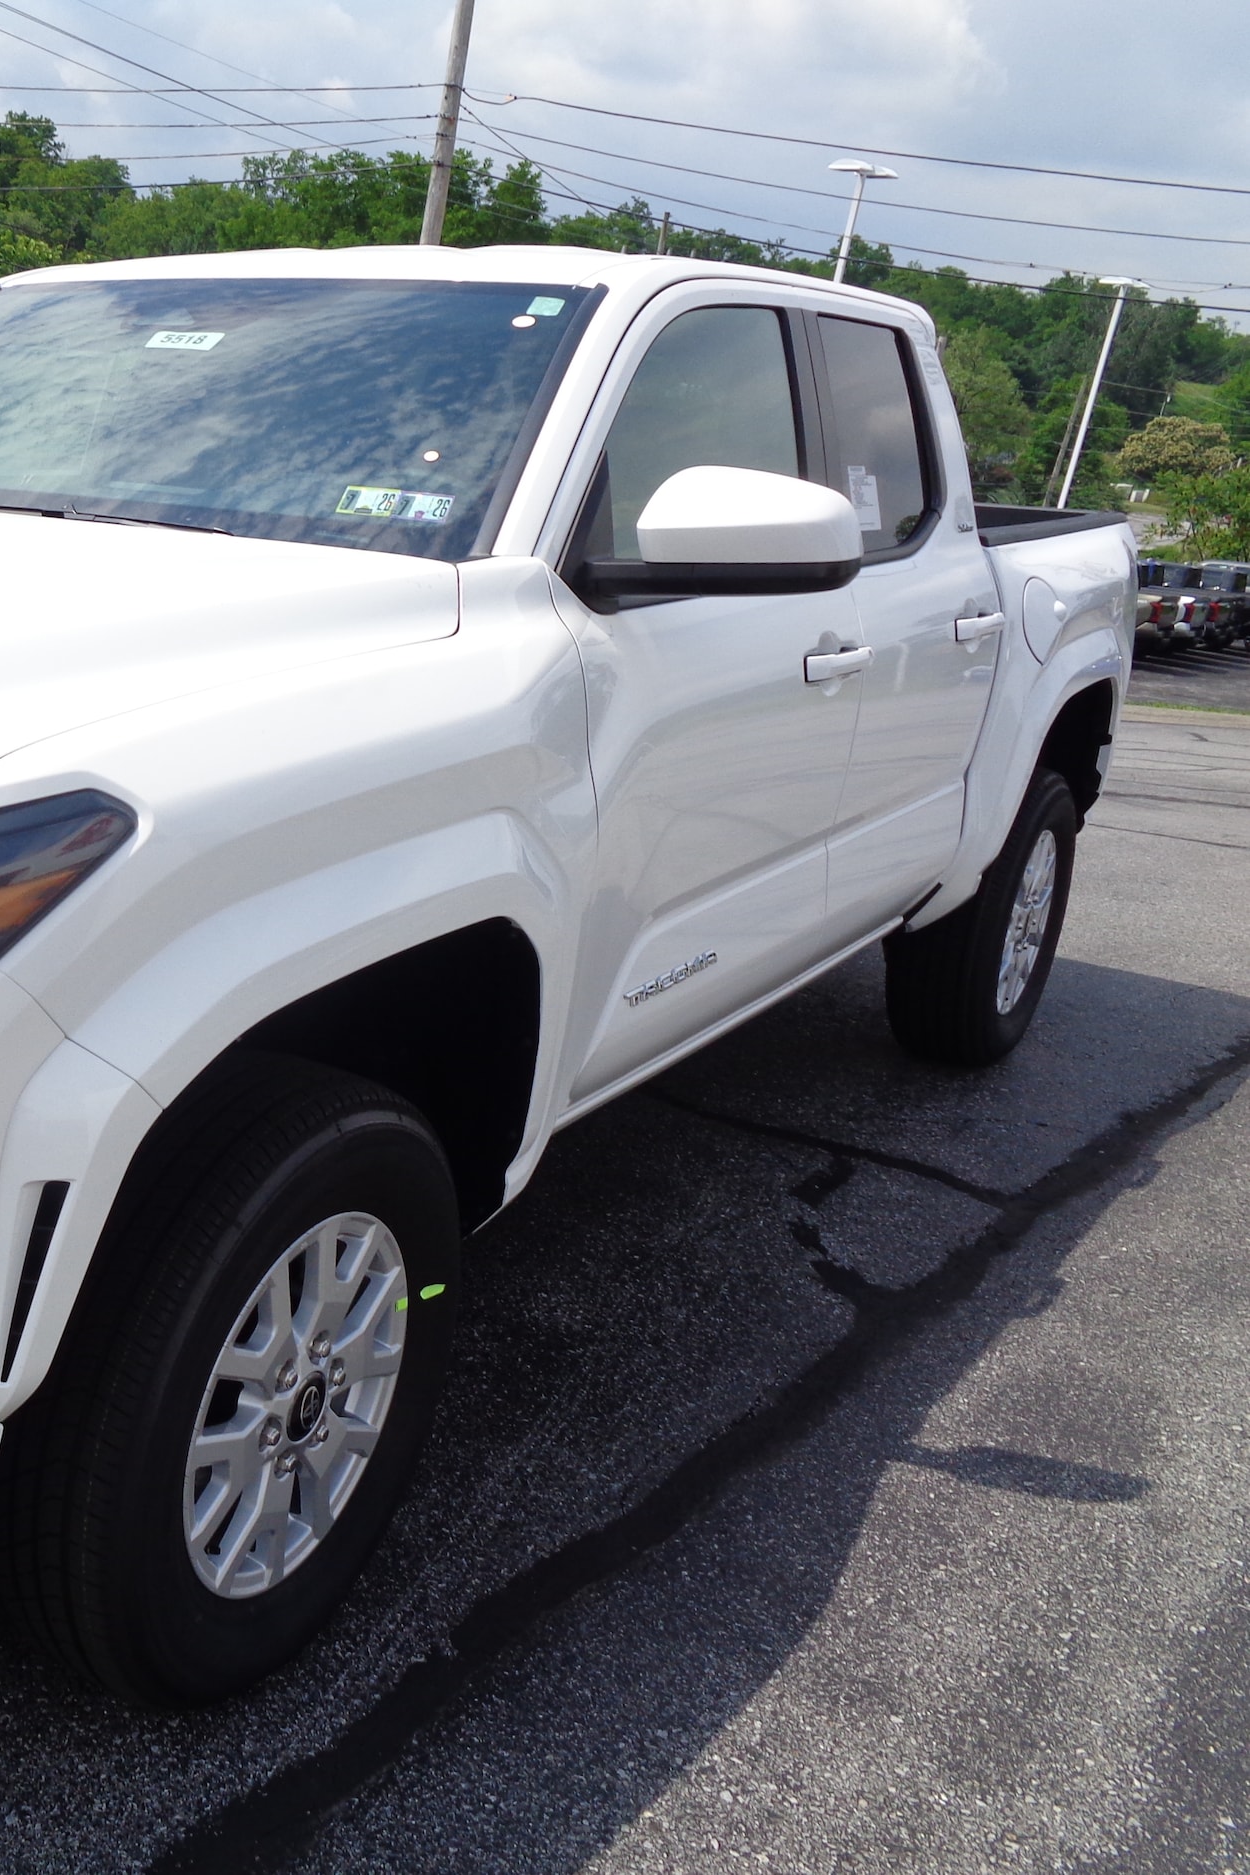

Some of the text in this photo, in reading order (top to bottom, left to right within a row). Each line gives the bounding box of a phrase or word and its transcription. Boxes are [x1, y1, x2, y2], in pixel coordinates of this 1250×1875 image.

[160, 334, 208, 345] 5518
[344, 493, 396, 512] 7 26
[397, 499, 451, 518] 7 26
[623, 949, 717, 1007] TACOMA
